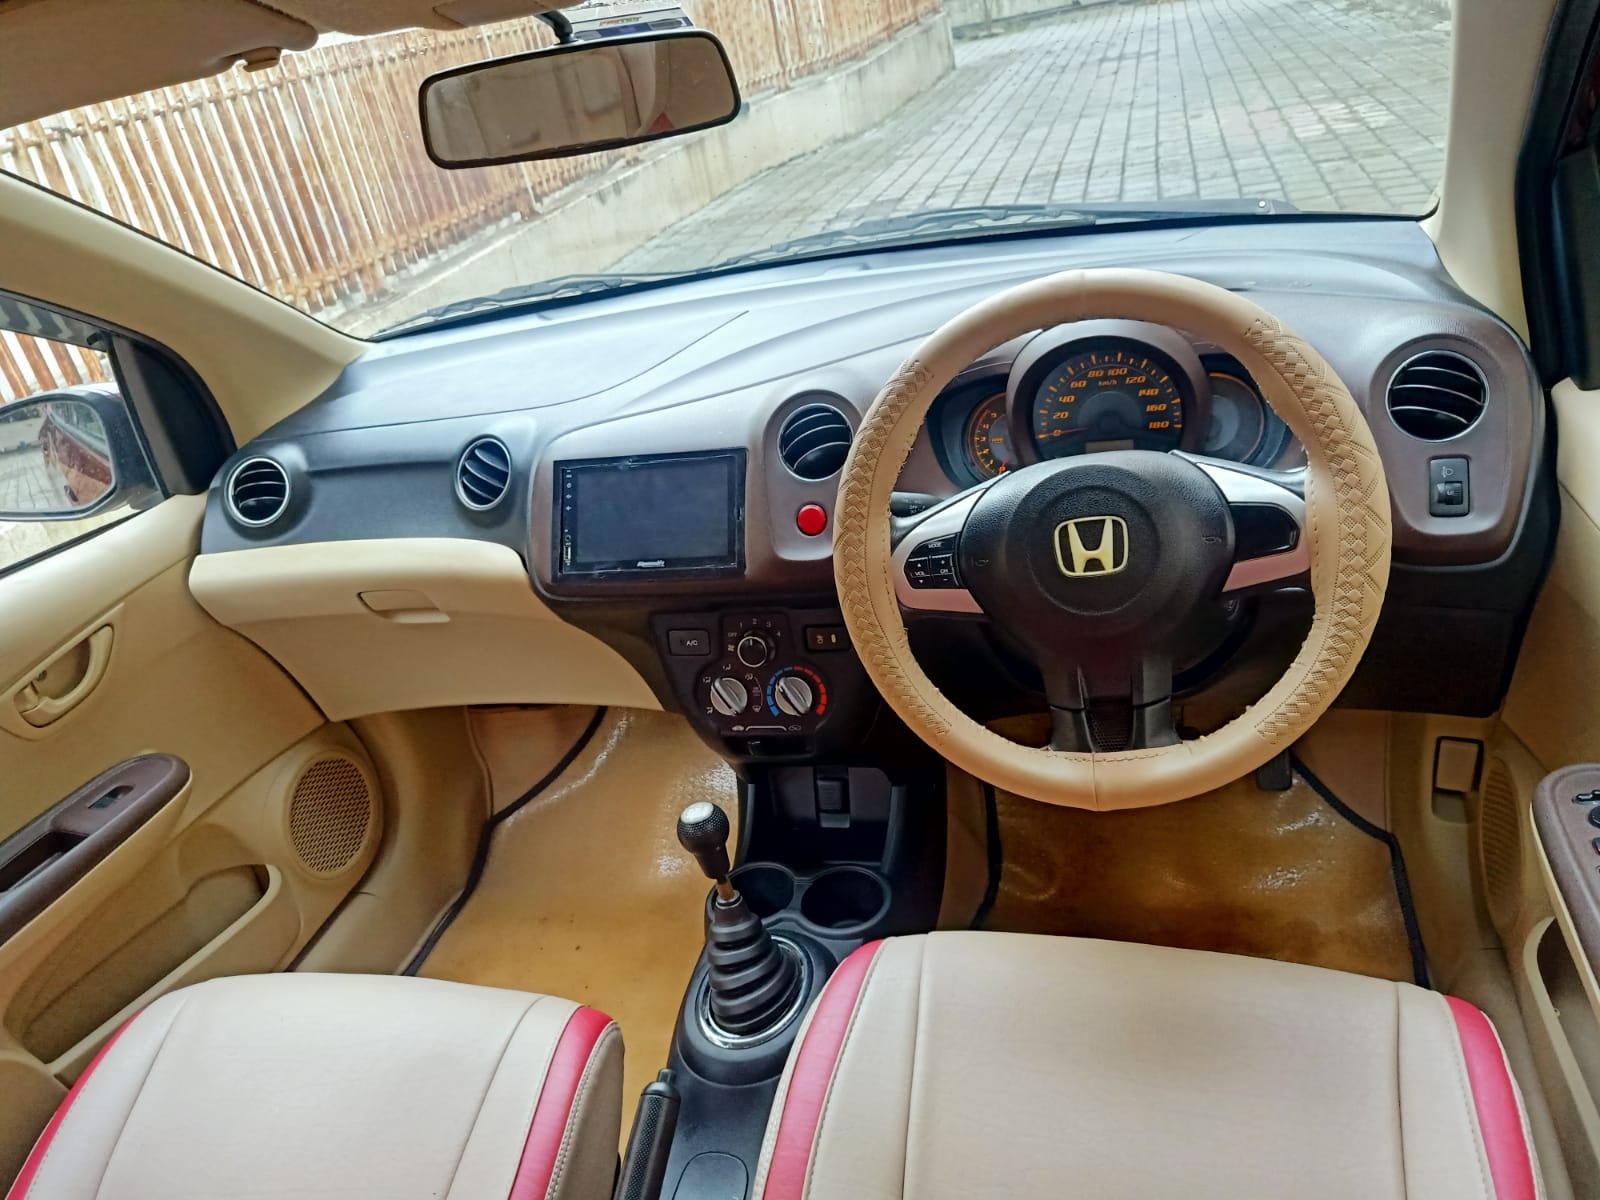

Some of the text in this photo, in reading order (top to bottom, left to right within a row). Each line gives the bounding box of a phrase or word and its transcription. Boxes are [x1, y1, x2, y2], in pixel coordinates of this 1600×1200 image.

[1088, 369, 1104, 378] 80
[1107, 367, 1128, 376] 100
[1125, 375, 1146, 384] 120
[1070, 380, 1087, 389] 60
[1138, 388, 1160, 396] 140
[1058, 395, 1075, 403] 40
[1146, 403, 1167, 412] 160
[1052, 411, 1069, 419] 20
[1149, 421, 1169, 429] 180
[686, 639, 698, 647] A/C
